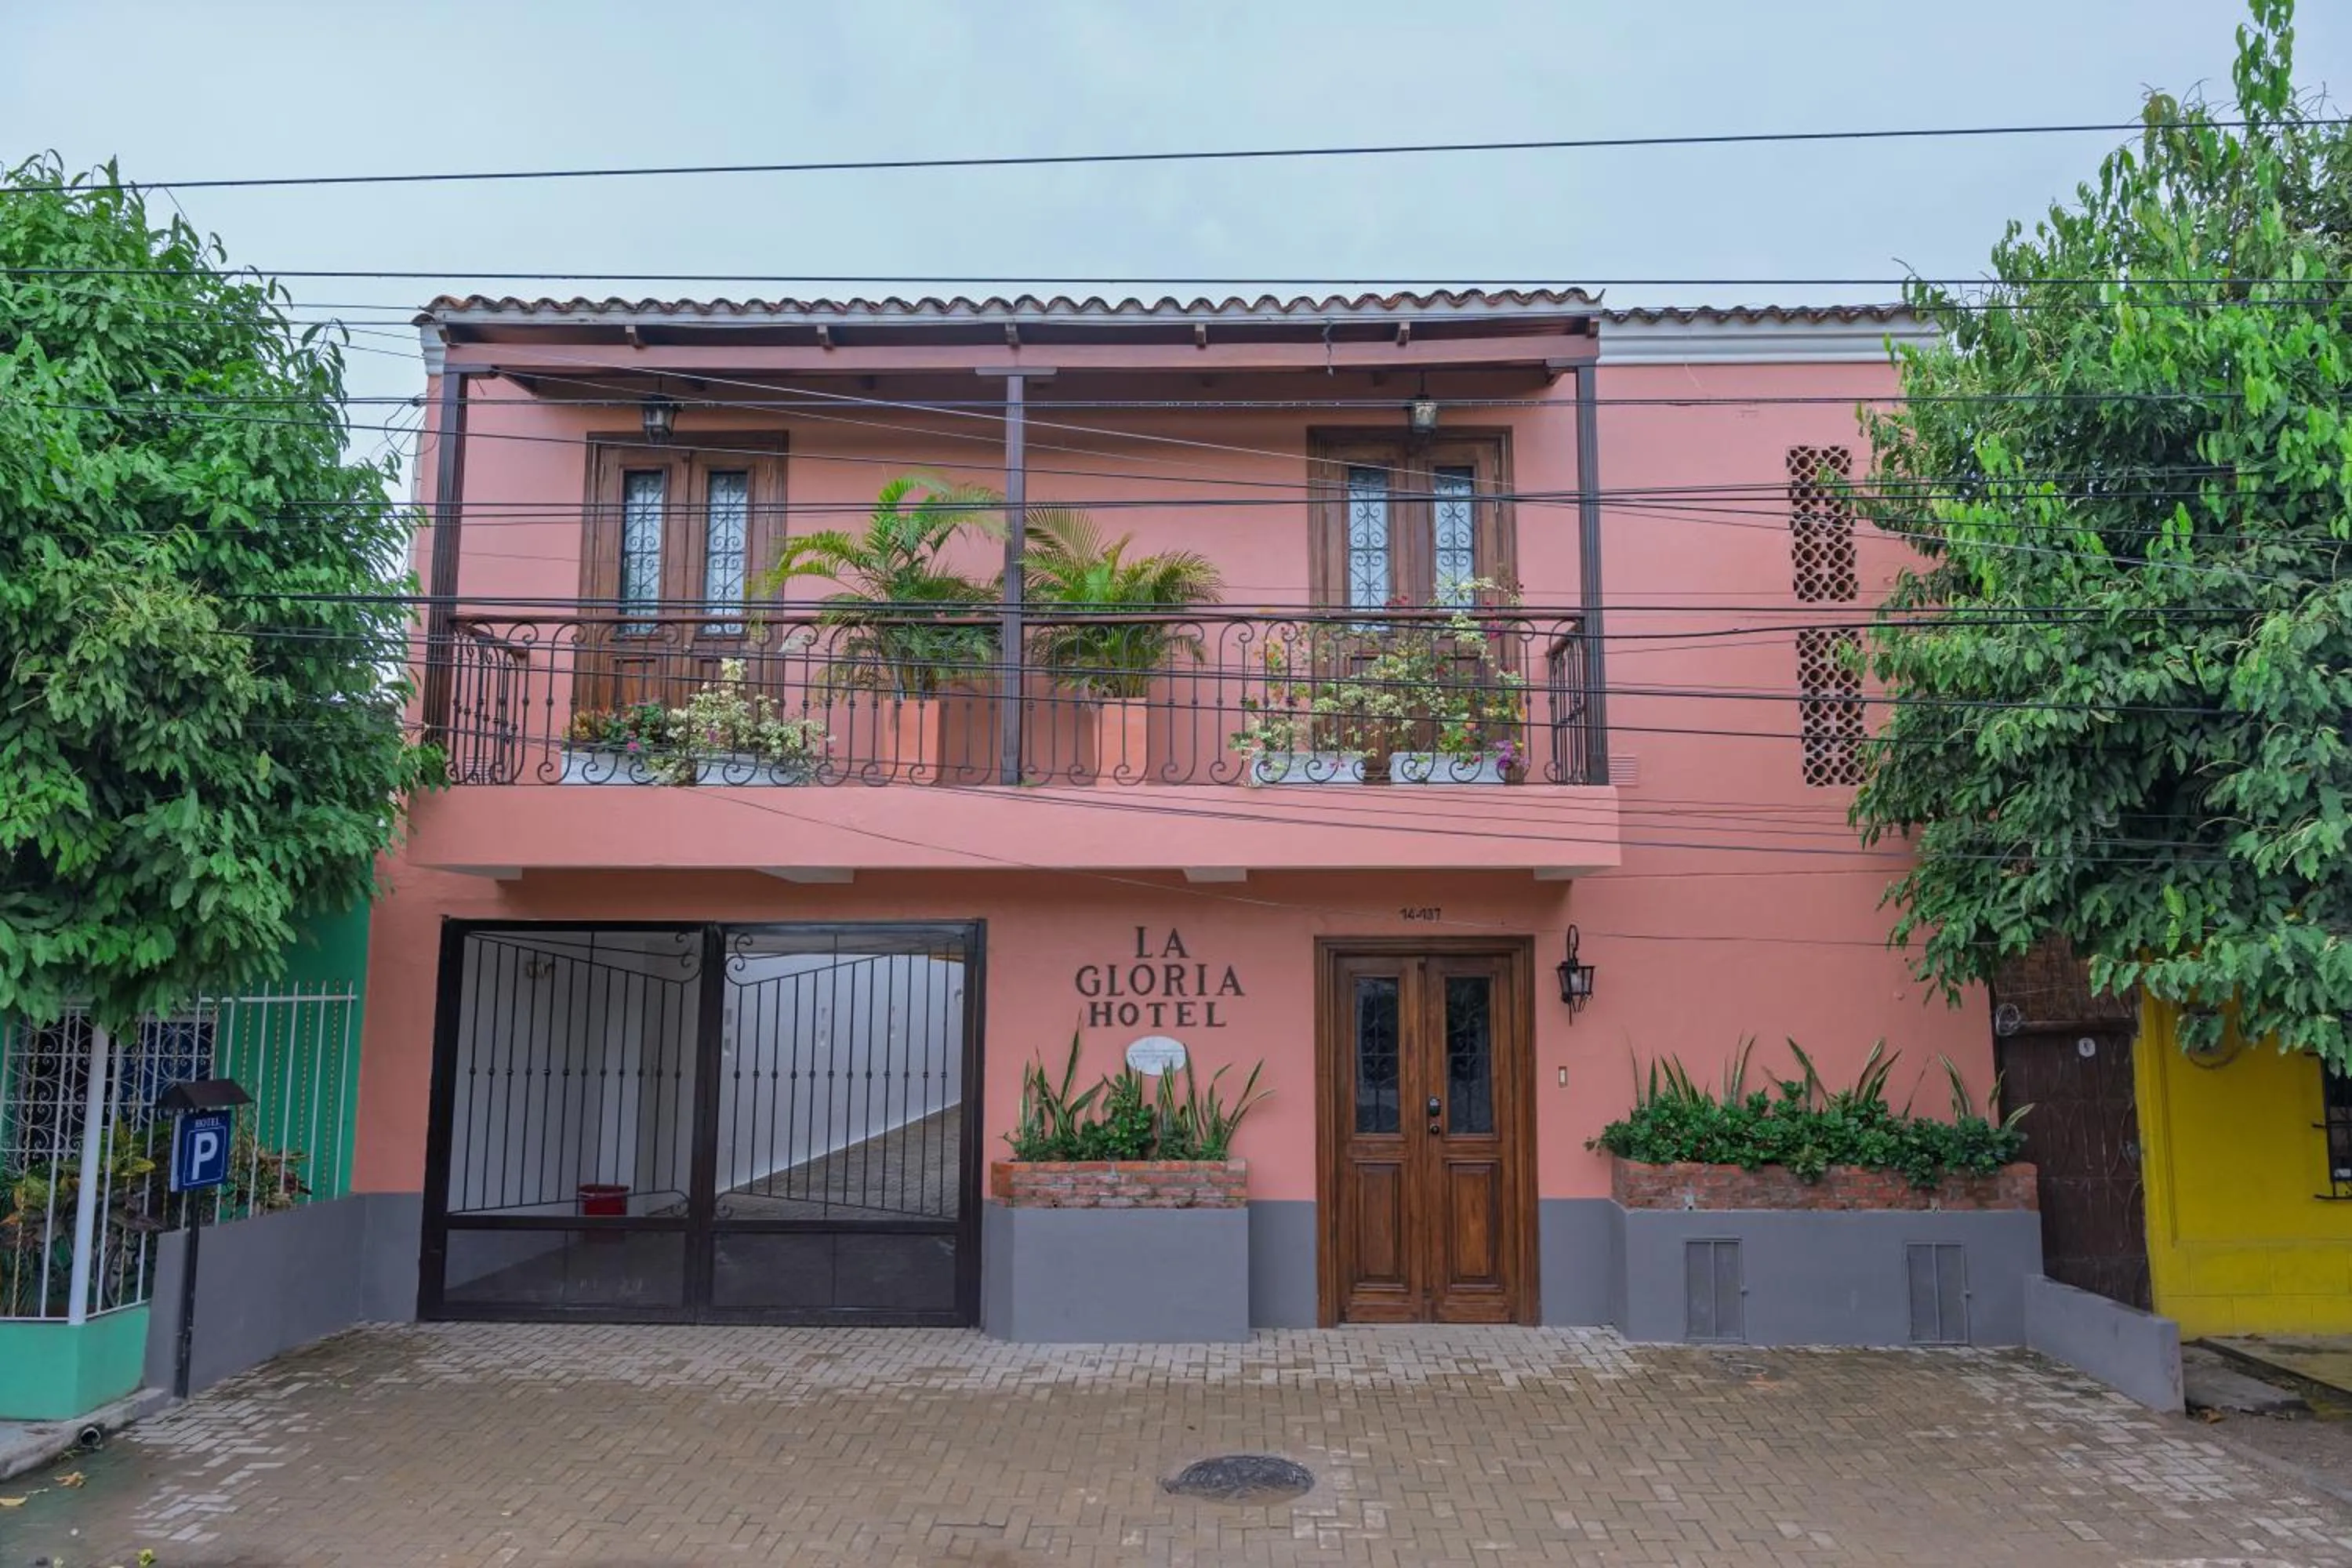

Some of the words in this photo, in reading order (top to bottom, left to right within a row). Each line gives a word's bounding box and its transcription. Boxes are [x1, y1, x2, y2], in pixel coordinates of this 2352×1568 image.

[1135, 926, 1190, 958] LA
[1075, 964, 1245, 996] GLORIA
[1088, 1001, 1227, 1027] HOTEL
[191, 1131, 218, 1180] P
